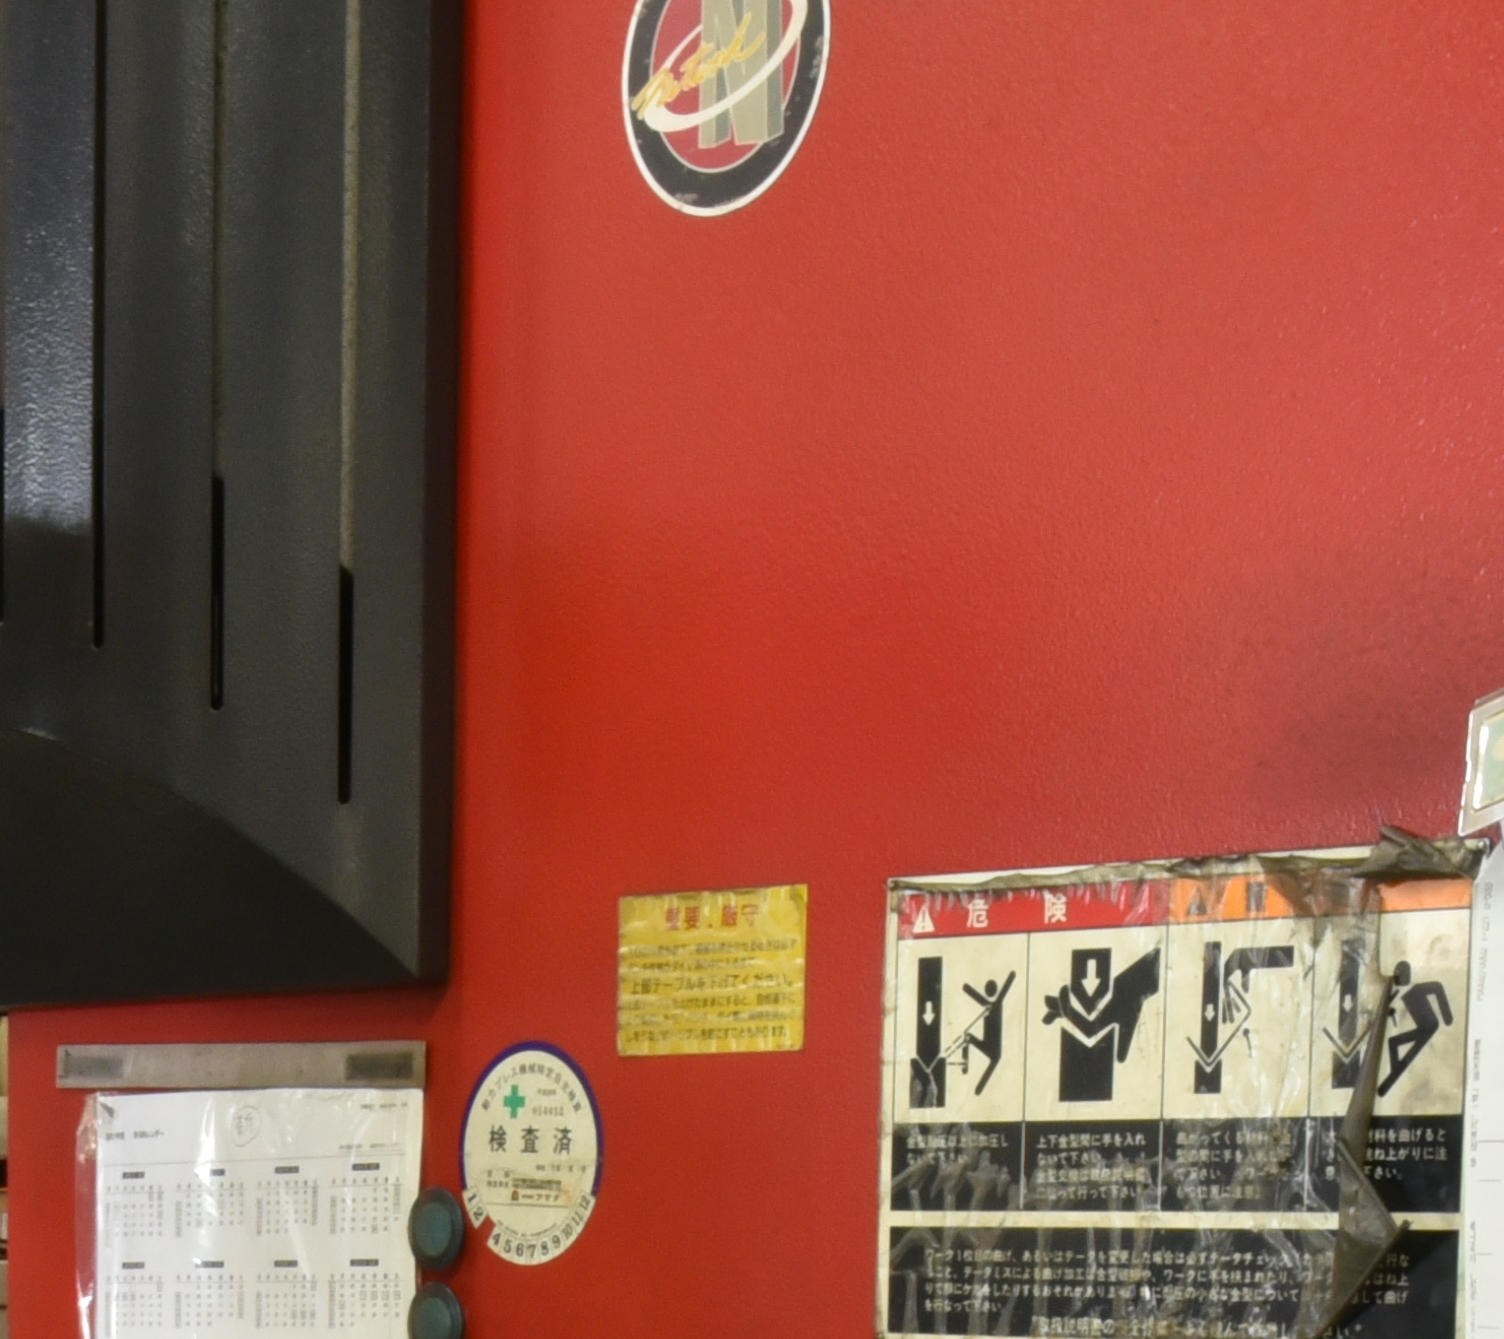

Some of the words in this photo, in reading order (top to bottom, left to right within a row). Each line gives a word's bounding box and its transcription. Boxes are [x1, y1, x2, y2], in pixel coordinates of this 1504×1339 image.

[488, 1124, 573, 1156] 検査済
[503, 1238, 513, 1254] 5
[515, 1241, 525, 1257] 6
[527, 1243, 537, 1259] 7
[540, 1240, 550, 1256] 8
[551, 1233, 562, 1250] 9
